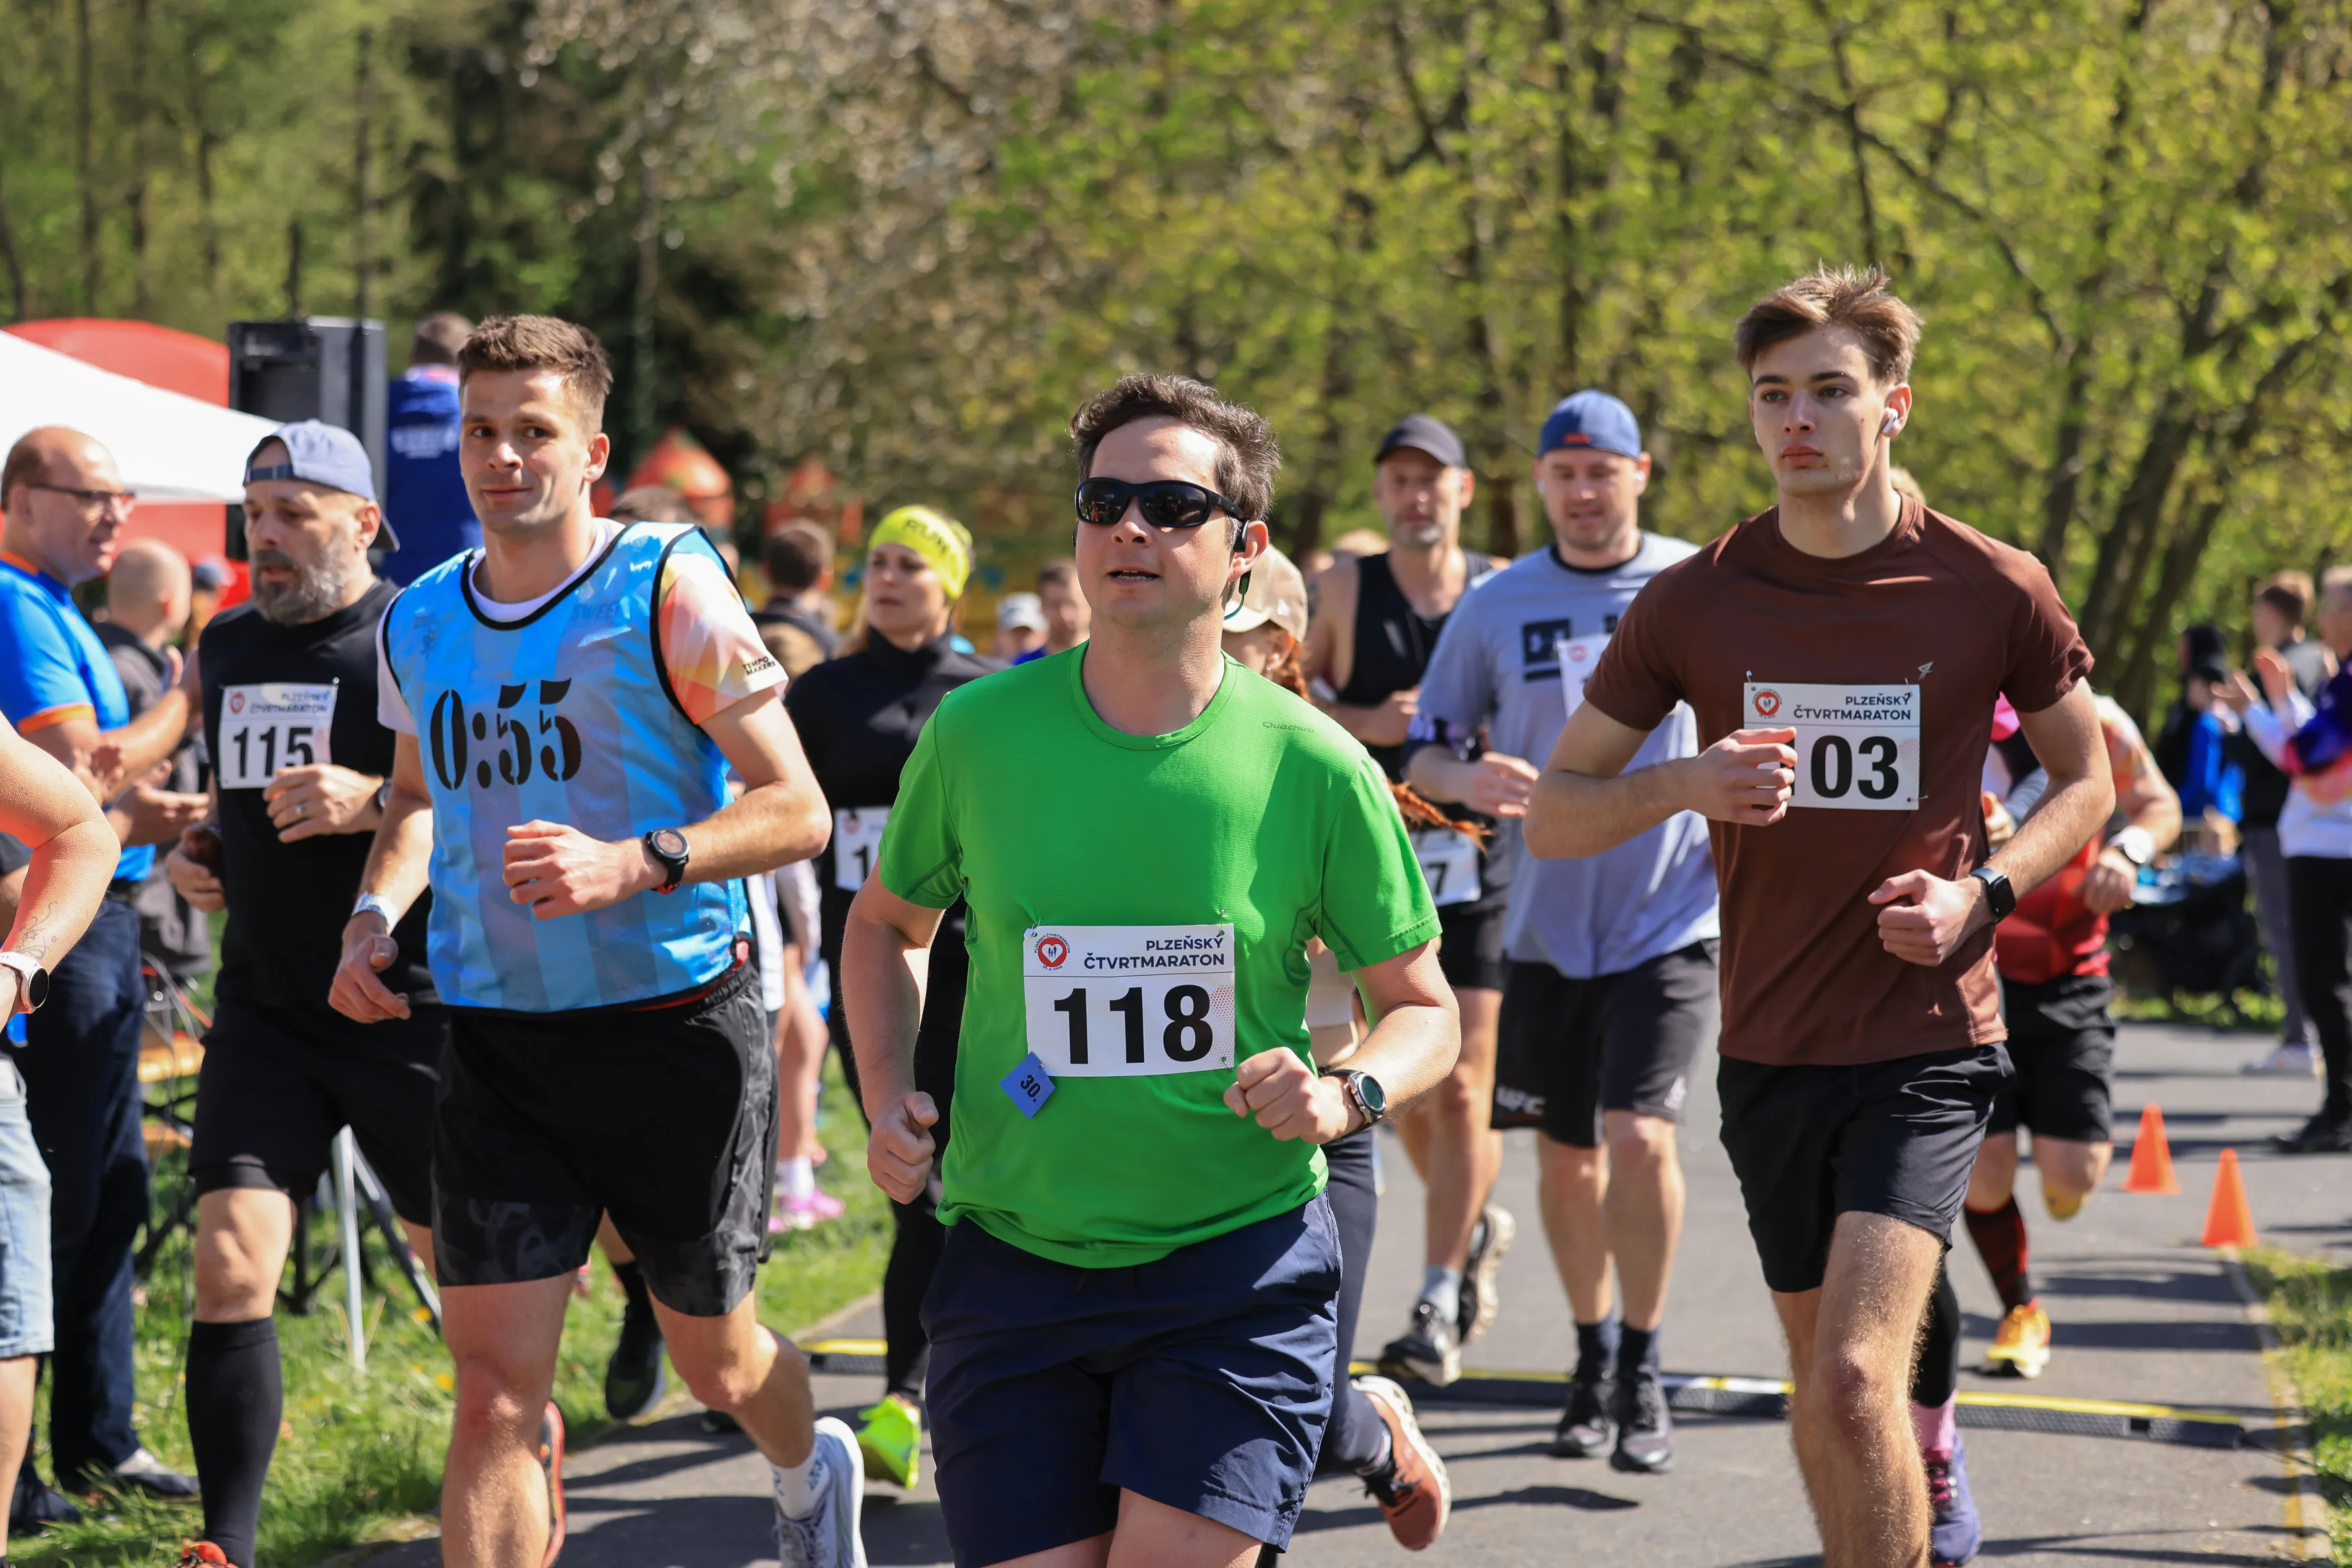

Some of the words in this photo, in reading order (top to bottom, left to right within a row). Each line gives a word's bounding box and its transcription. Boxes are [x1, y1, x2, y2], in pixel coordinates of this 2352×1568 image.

[742, 656, 769, 670] TEMPO
[746, 660, 776, 676] MAKERS
[1845, 693, 1910, 705] PLZEŇSKÝ
[1794, 705, 1910, 721] ČTVRTMARATON
[430, 678, 581, 790] 0:55
[1262, 722, 1314, 733] Quechua
[233, 726, 314, 778] 115
[1146, 934, 1224, 951] PLZEŇSKÝ
[1084, 952, 1225, 969] ČTVRTMARATON
[1054, 984, 1214, 1065] 118
[1020, 1074, 1041, 1102] 30.
